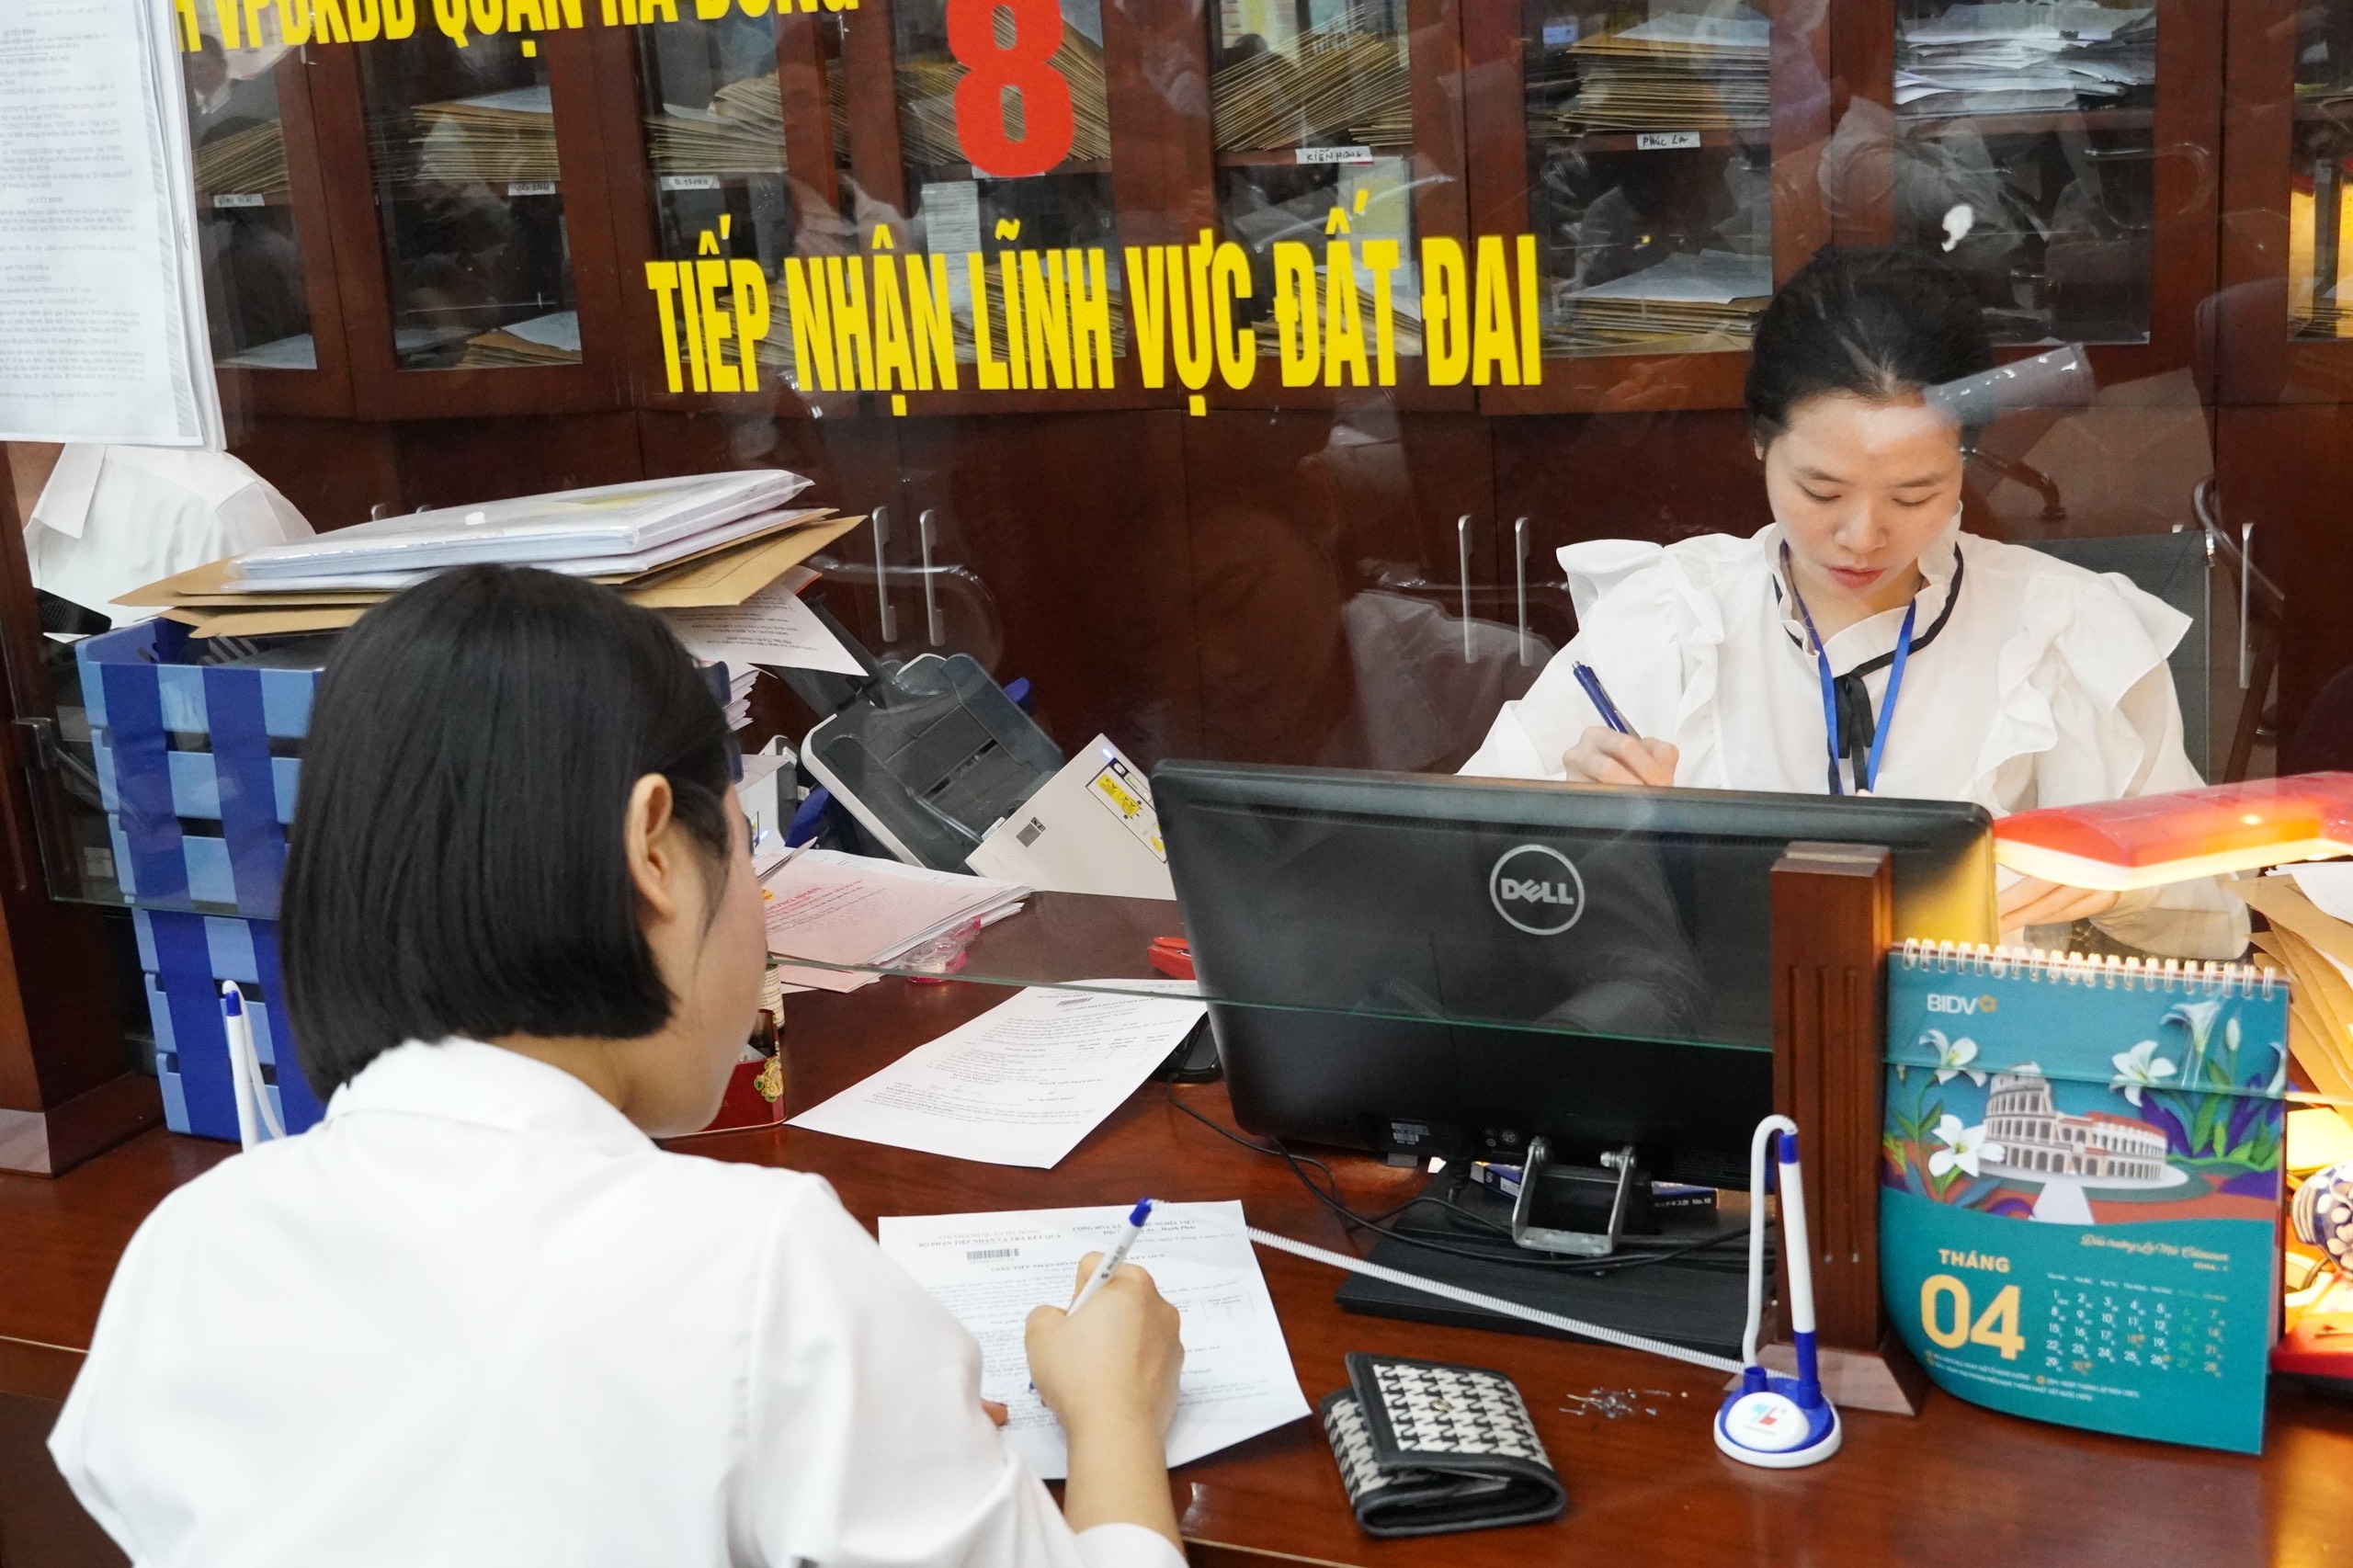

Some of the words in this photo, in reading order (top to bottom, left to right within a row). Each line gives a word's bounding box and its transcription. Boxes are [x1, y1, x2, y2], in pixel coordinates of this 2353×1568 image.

[946, 0, 1074, 177] 8
[645, 213, 771, 392] TIẾP
[784, 224, 958, 417] NHẬN
[970, 218, 1115, 391] LĨNH
[1124, 228, 1256, 417] VỰC
[1272, 188, 1399, 389] ĐẤT
[1421, 234, 1542, 387] ĐAI
[1500, 878, 1574, 905] DELL
[1927, 994, 1979, 1016] BIDV
[1938, 1248, 2011, 1274] THÁNG
[2077, 1292, 2086, 1303] 2
[2103, 1296, 2112, 1307] 3
[2130, 1299, 2138, 1310] 4
[2156, 1302, 2165, 1314] 5
[1920, 1273, 2026, 1361] 04
[2051, 1305, 2059, 1317] 8
[2076, 1309, 2086, 1320] 9
[2102, 1312, 2113, 1324] 10
[2128, 1316, 2139, 1327] 11
[2154, 1319, 2165, 1332] 12
[2049, 1323, 2060, 1335] 15
[2075, 1326, 2086, 1338] 16
[2100, 1329, 2111, 1341] 17
[2154, 1336, 2165, 1348] 19
[2045, 1339, 2059, 1351] 22
[2072, 1343, 2085, 1355] 23
[2097, 1346, 2111, 1358] 24
[2124, 1350, 2137, 1362] 25
[2150, 1353, 2163, 1366] 26
[2045, 1356, 2059, 1368] 29
